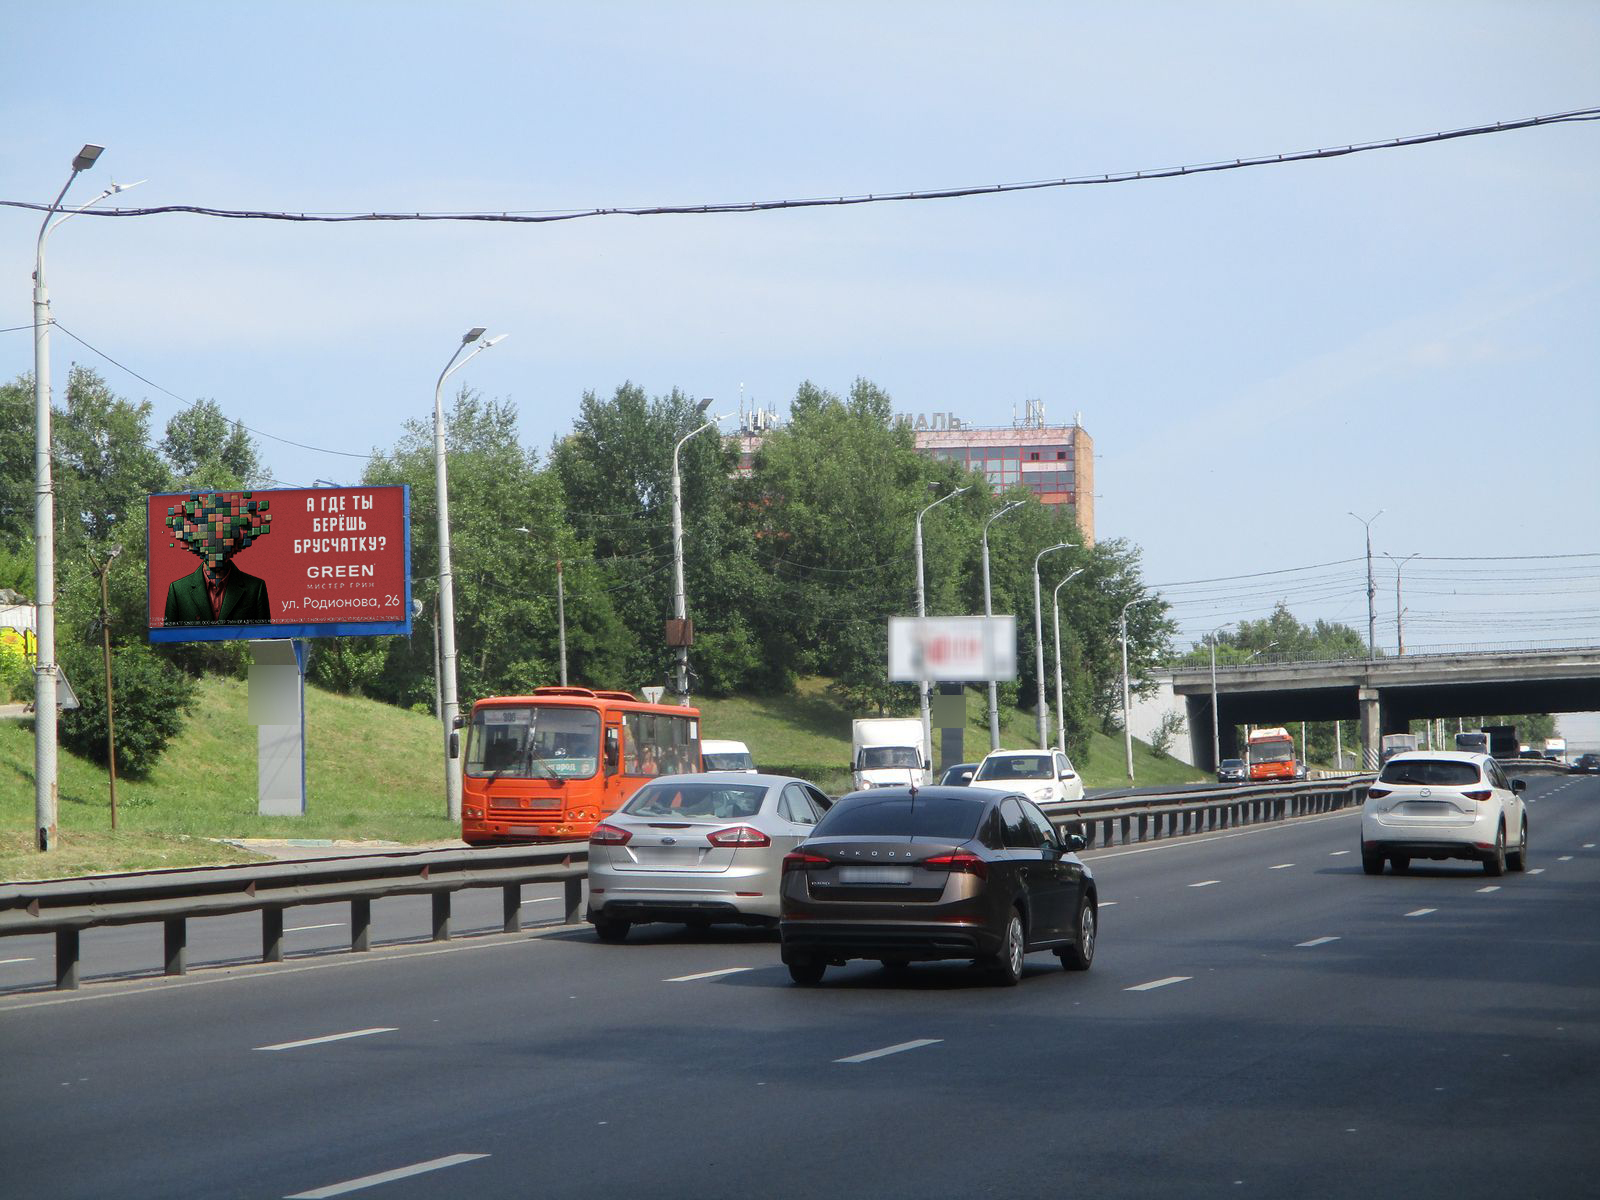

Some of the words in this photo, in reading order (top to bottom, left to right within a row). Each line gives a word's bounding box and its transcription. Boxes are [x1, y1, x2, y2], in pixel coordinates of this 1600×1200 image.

[306, 497, 315, 512] А
[321, 496, 346, 513] ГДЕ
[352, 495, 373, 510] ТЫ
[313, 514, 367, 532] БЕРЁШЬ
[294, 536, 387, 554] БРУСЧАТКУ?
[306, 564, 374, 579] GREEN
[306, 582, 345, 590] МИСТЕР
[281, 600, 299, 613] ул.
[303, 596, 381, 611] Родионова,
[384, 594, 400, 607] 26
